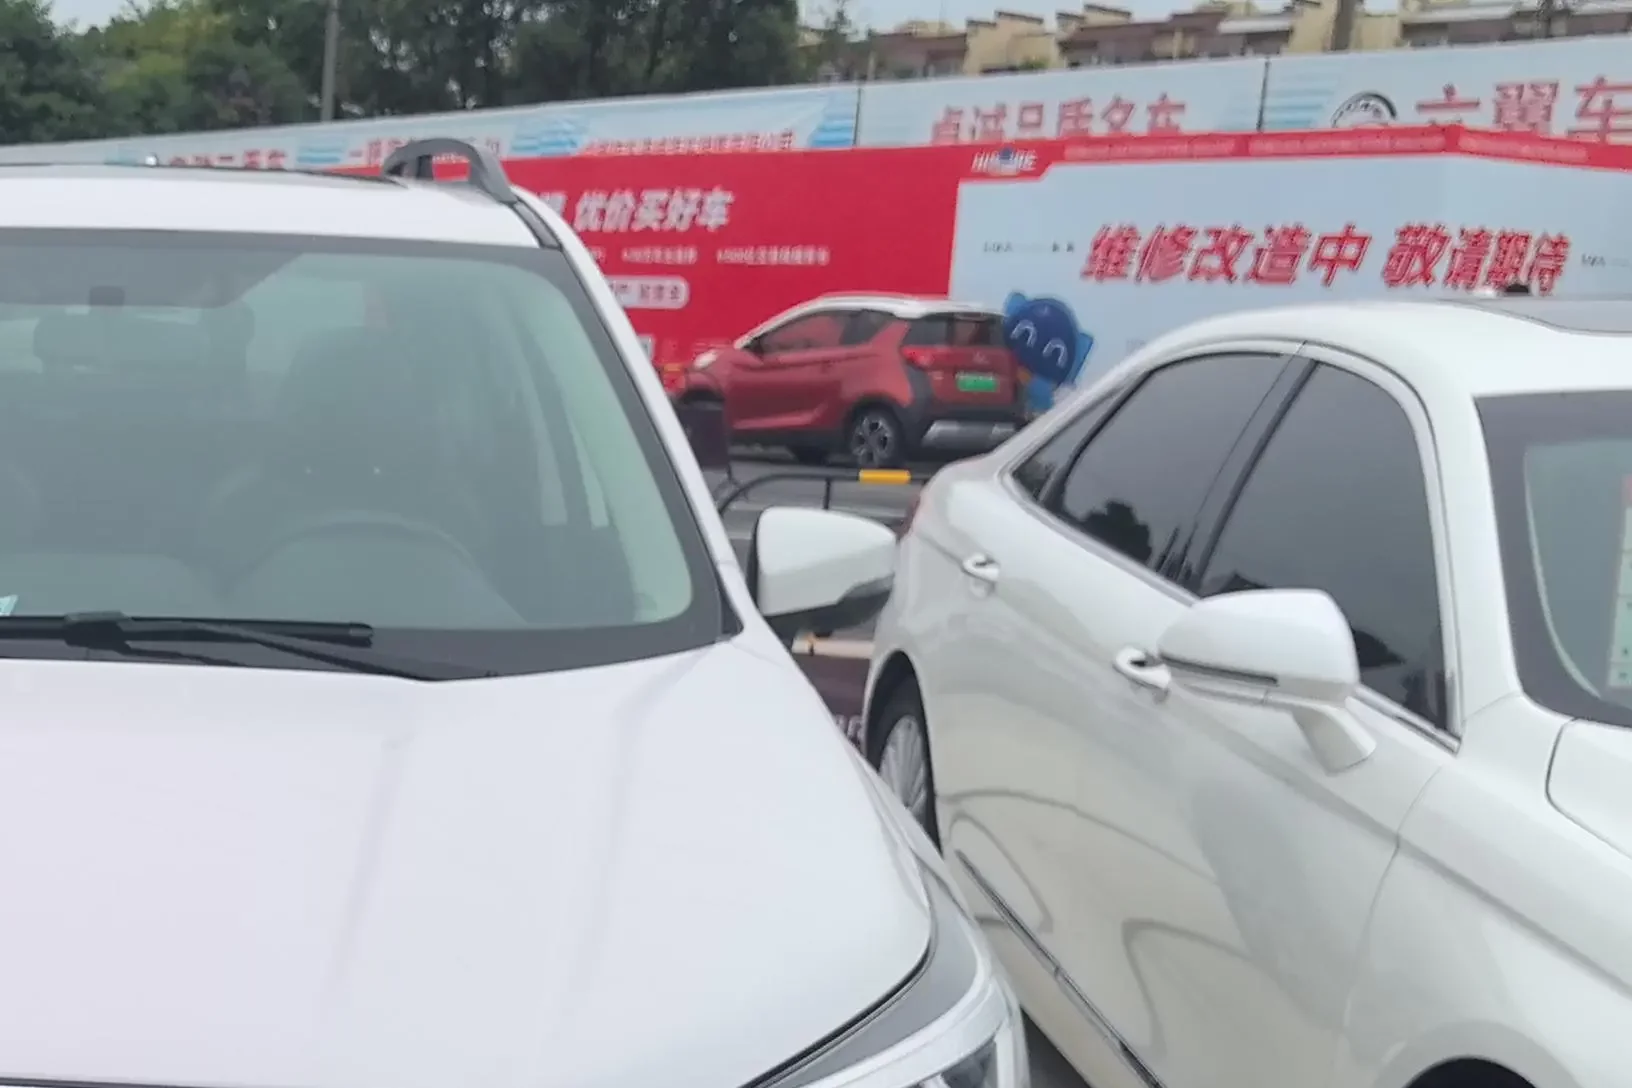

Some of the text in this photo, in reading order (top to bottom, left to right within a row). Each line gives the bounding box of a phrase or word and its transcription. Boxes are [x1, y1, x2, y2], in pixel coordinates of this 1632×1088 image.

[1081, 221, 1571, 297] 维修改造中 敬请期待
